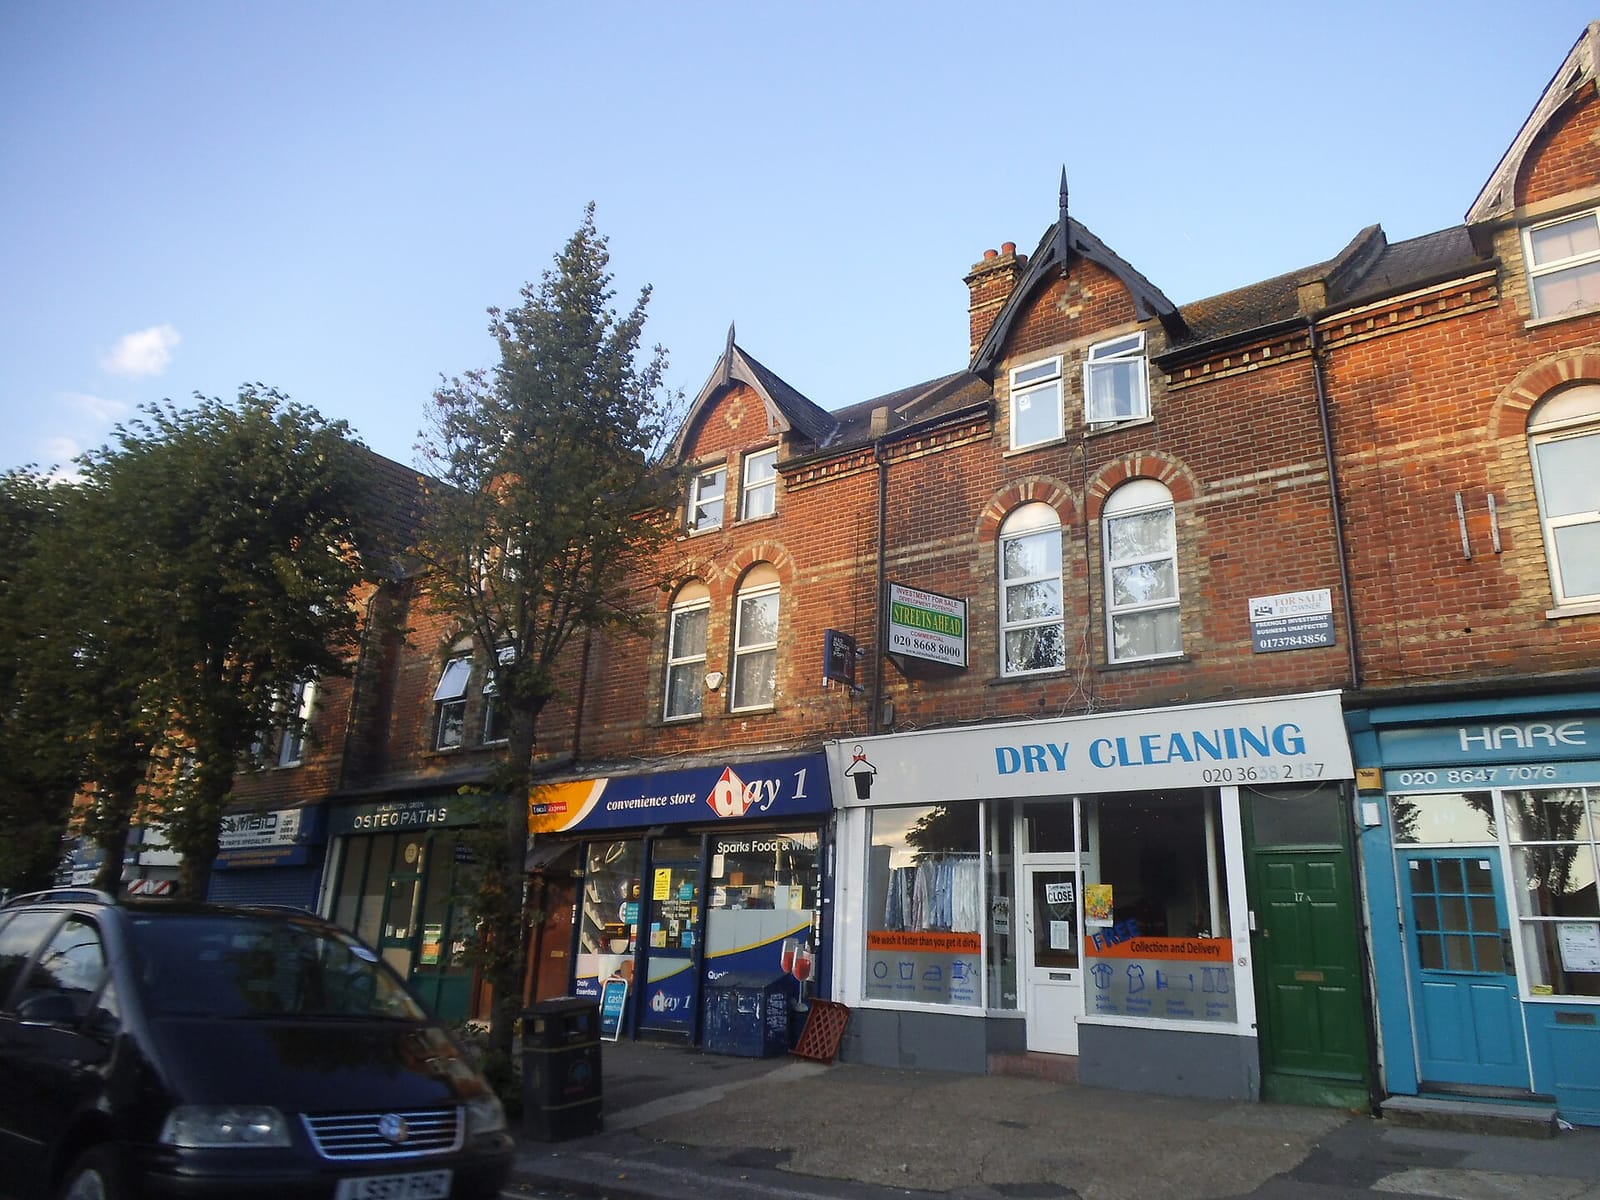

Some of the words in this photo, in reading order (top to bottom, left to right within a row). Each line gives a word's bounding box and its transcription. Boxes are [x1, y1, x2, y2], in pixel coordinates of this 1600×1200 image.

[1275, 596, 1296, 607] FOR
[1296, 593, 1326, 604] SALE
[894, 604, 932, 629] STREETS
[933, 613, 960, 634] AHEAD
[1255, 620, 1287, 628] FREEHOLD
[1287, 615, 1328, 624] INVESTMENT
[910, 631, 944, 642] COMMERCIAL
[1256, 627, 1287, 635] BUSINESS
[893, 634, 911, 647] 020
[913, 639, 936, 653] 8668
[938, 644, 960, 658] 8000
[1260, 632, 1327, 649] 01737843856
[1459, 721, 1586, 751] HARE
[995, 742, 1069, 775] DRY
[1089, 723, 1306, 769] CLEANING
[1202, 768, 1232, 783] 020
[1400, 771, 1438, 786] 020
[1447, 768, 1498, 784] 8647
[1506, 766, 1556, 781] 7076
[606, 795, 667, 811] convenience
[669, 793, 696, 805] store
[791, 768, 807, 799] 1
[353, 808, 447, 829] OSTEOPATHS
[717, 841, 749, 855] Sparks
[752, 841, 778, 852] Food
[781, 841, 790, 851] &
[1048, 891, 1073, 903] CLOSE
[871, 935, 880, 945] We
[881, 935, 896, 945] wash
[901, 935, 918, 945] faster
[920, 935, 934, 946] than
[934, 939, 944, 949] you
[946, 938, 956, 949] get
[1092, 918, 1140, 952] FREE
[1130, 941, 1169, 953] Collection
[1171, 942, 1186, 953] and
[1187, 942, 1221, 956] Delivery
[683, 995, 692, 1008] 1
